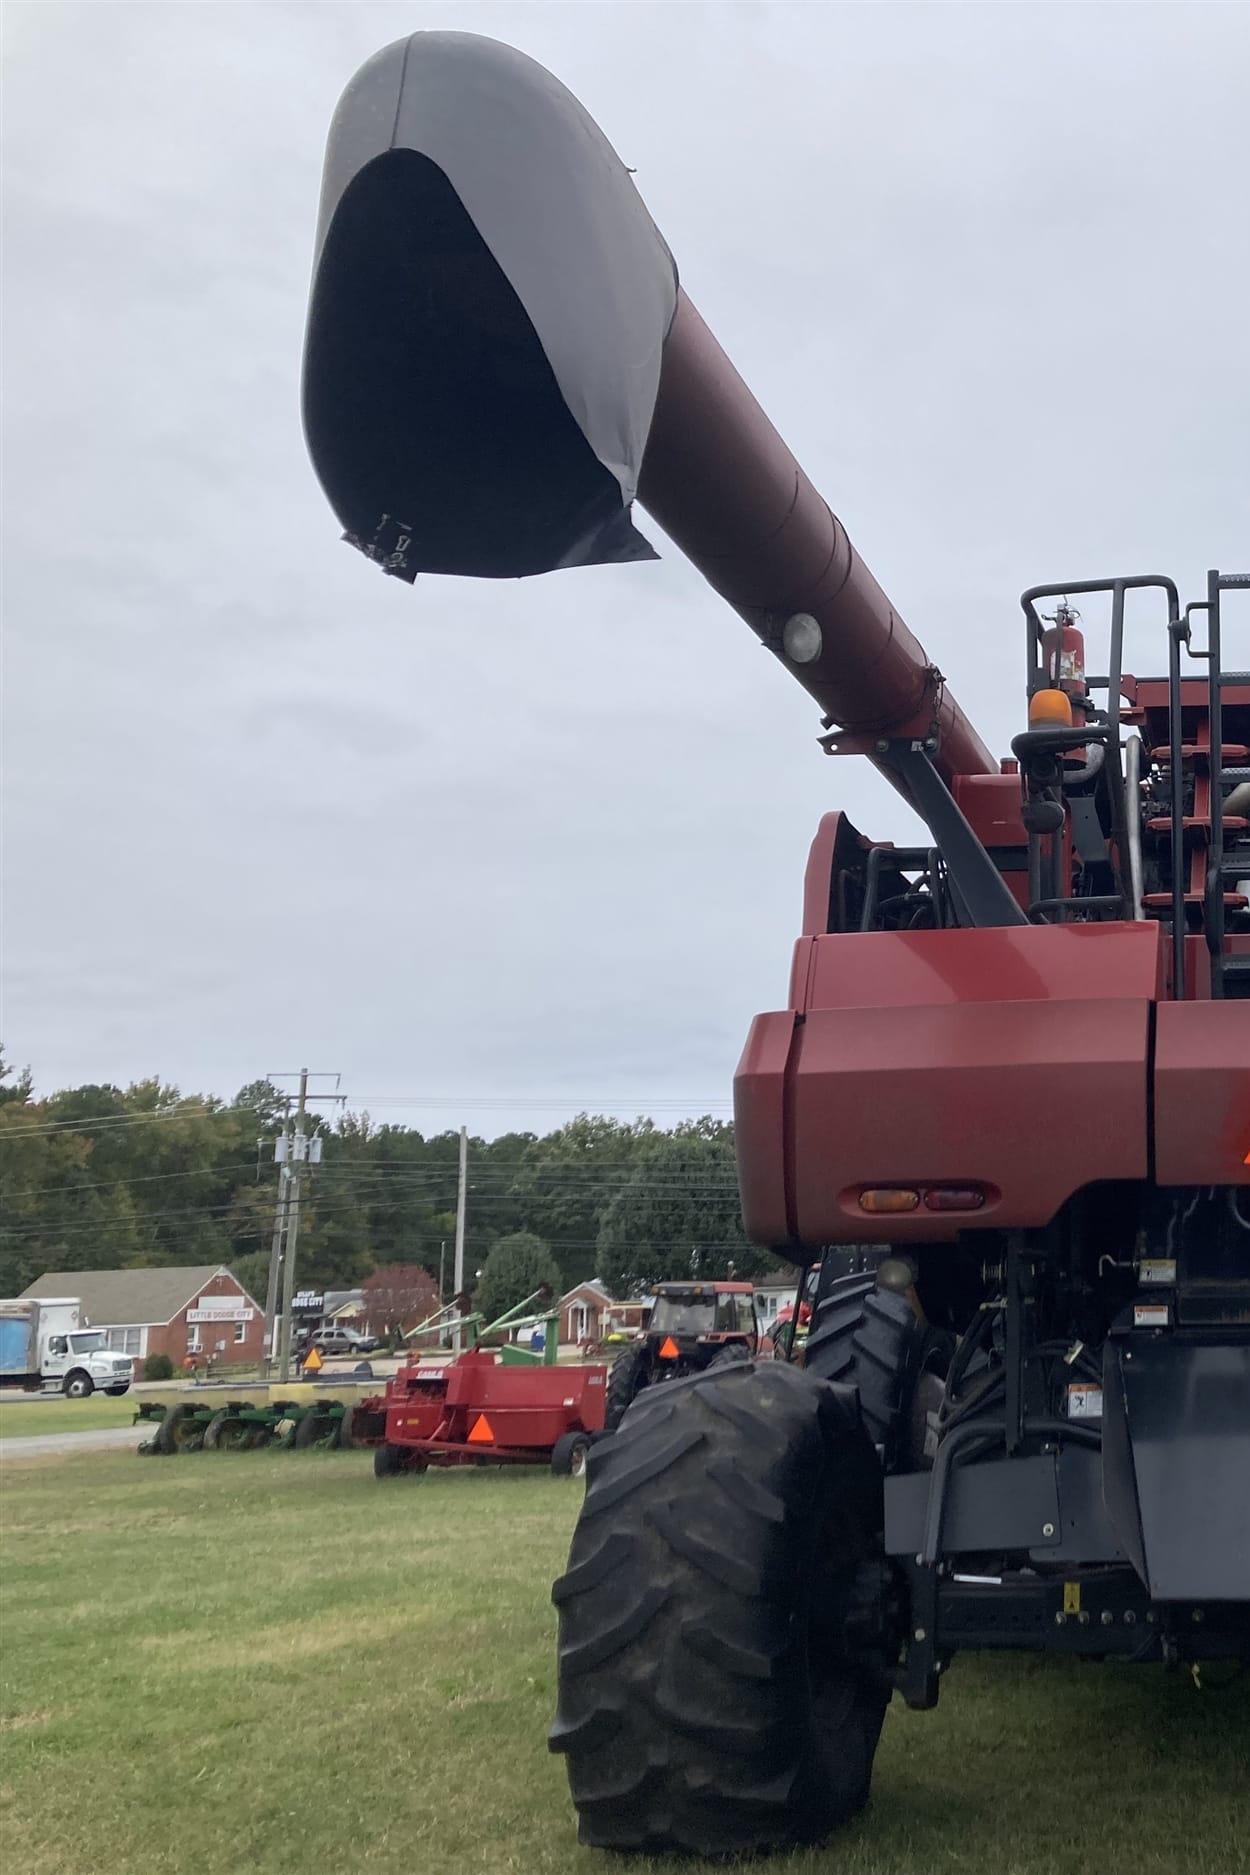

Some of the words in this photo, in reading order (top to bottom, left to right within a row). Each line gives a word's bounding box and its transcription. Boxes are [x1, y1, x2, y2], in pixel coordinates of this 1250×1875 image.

[190, 1311, 212, 1320] LITTLE
[213, 1311, 235, 1319] DODGE
[236, 1310, 251, 1318] CITY
